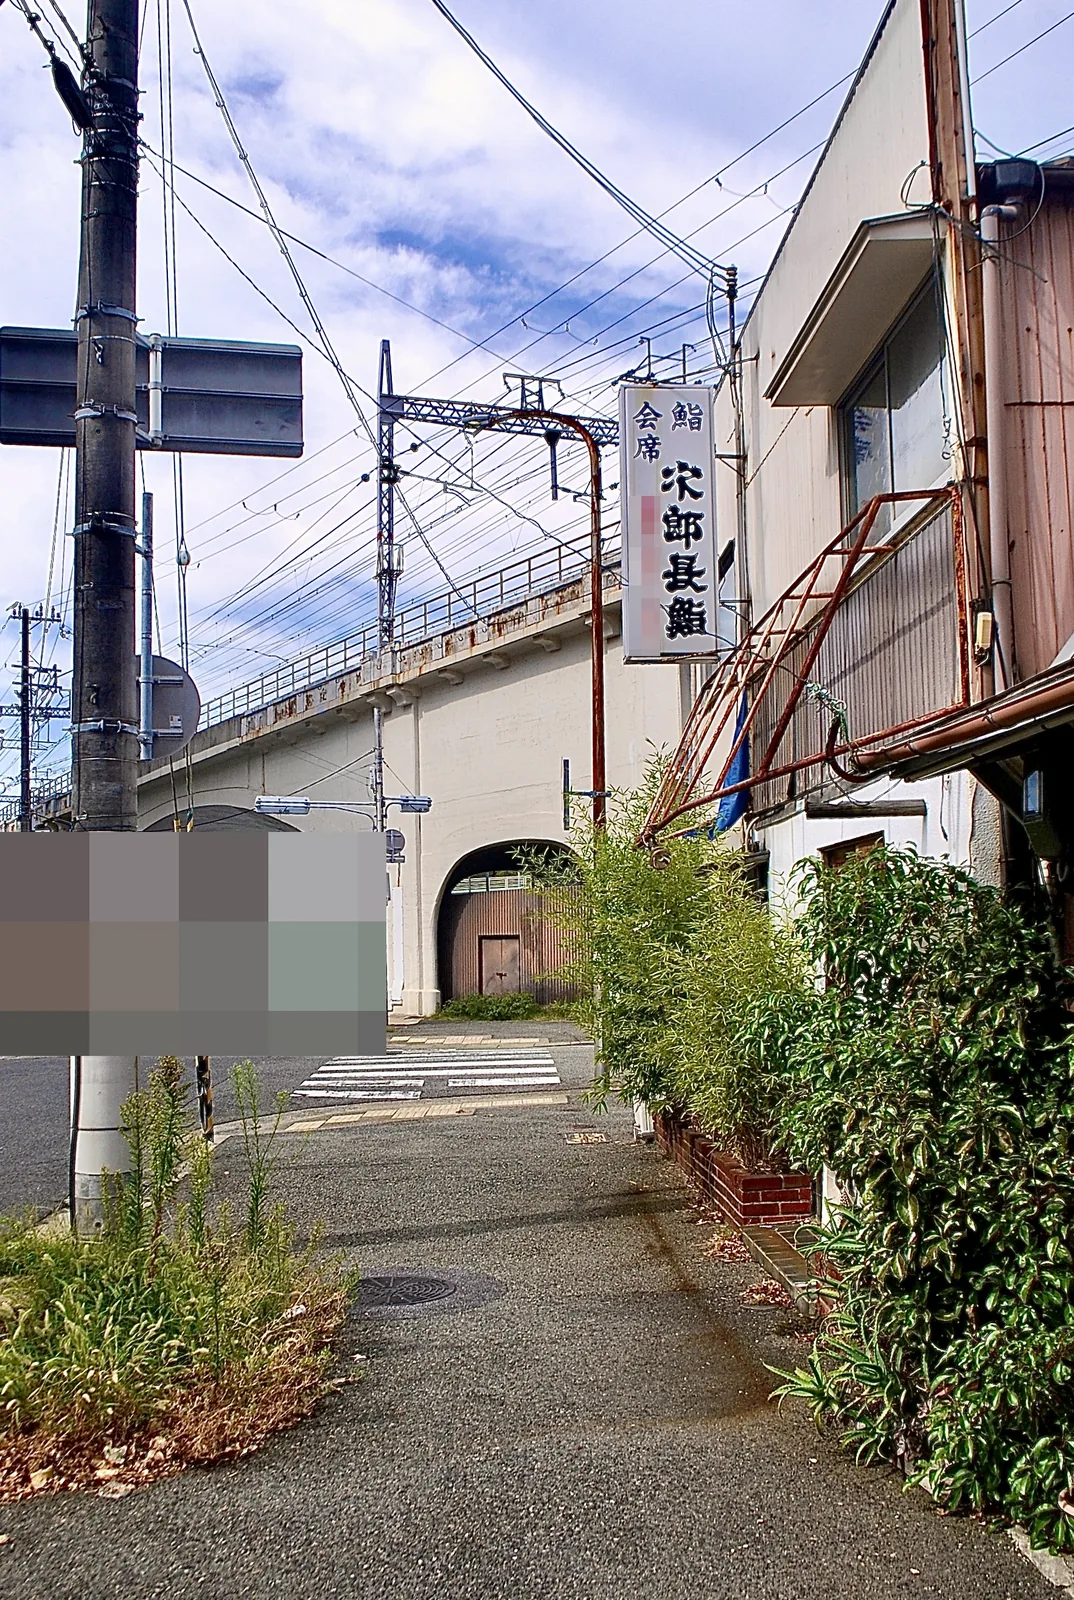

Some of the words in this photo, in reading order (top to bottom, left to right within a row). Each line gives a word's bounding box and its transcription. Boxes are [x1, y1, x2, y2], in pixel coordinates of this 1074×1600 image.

[633, 401, 663, 463] 会席
[671, 401, 703, 431] 鮨
[660, 460, 707, 640] 次郎長鮨
